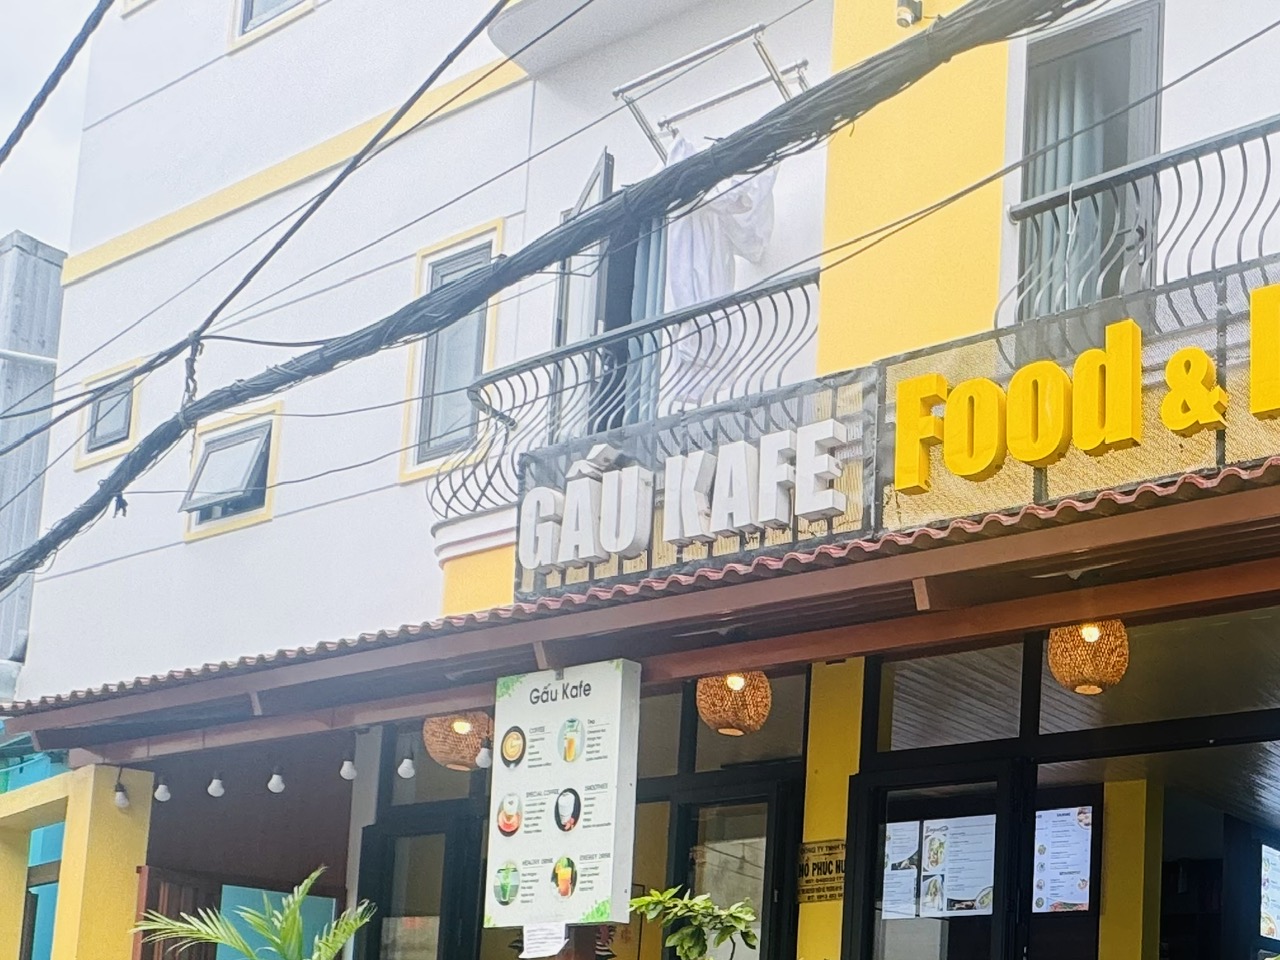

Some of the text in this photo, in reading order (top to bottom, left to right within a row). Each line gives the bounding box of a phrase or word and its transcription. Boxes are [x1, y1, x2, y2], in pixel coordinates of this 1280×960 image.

[894, 318, 1142, 495] Food
[1161, 346, 1229, 438] &
[519, 418, 848, 571] GẤU KAFE
[529, 680, 592, 705] Gấu Kafe
[812, 857, 833, 877] PHÚC
